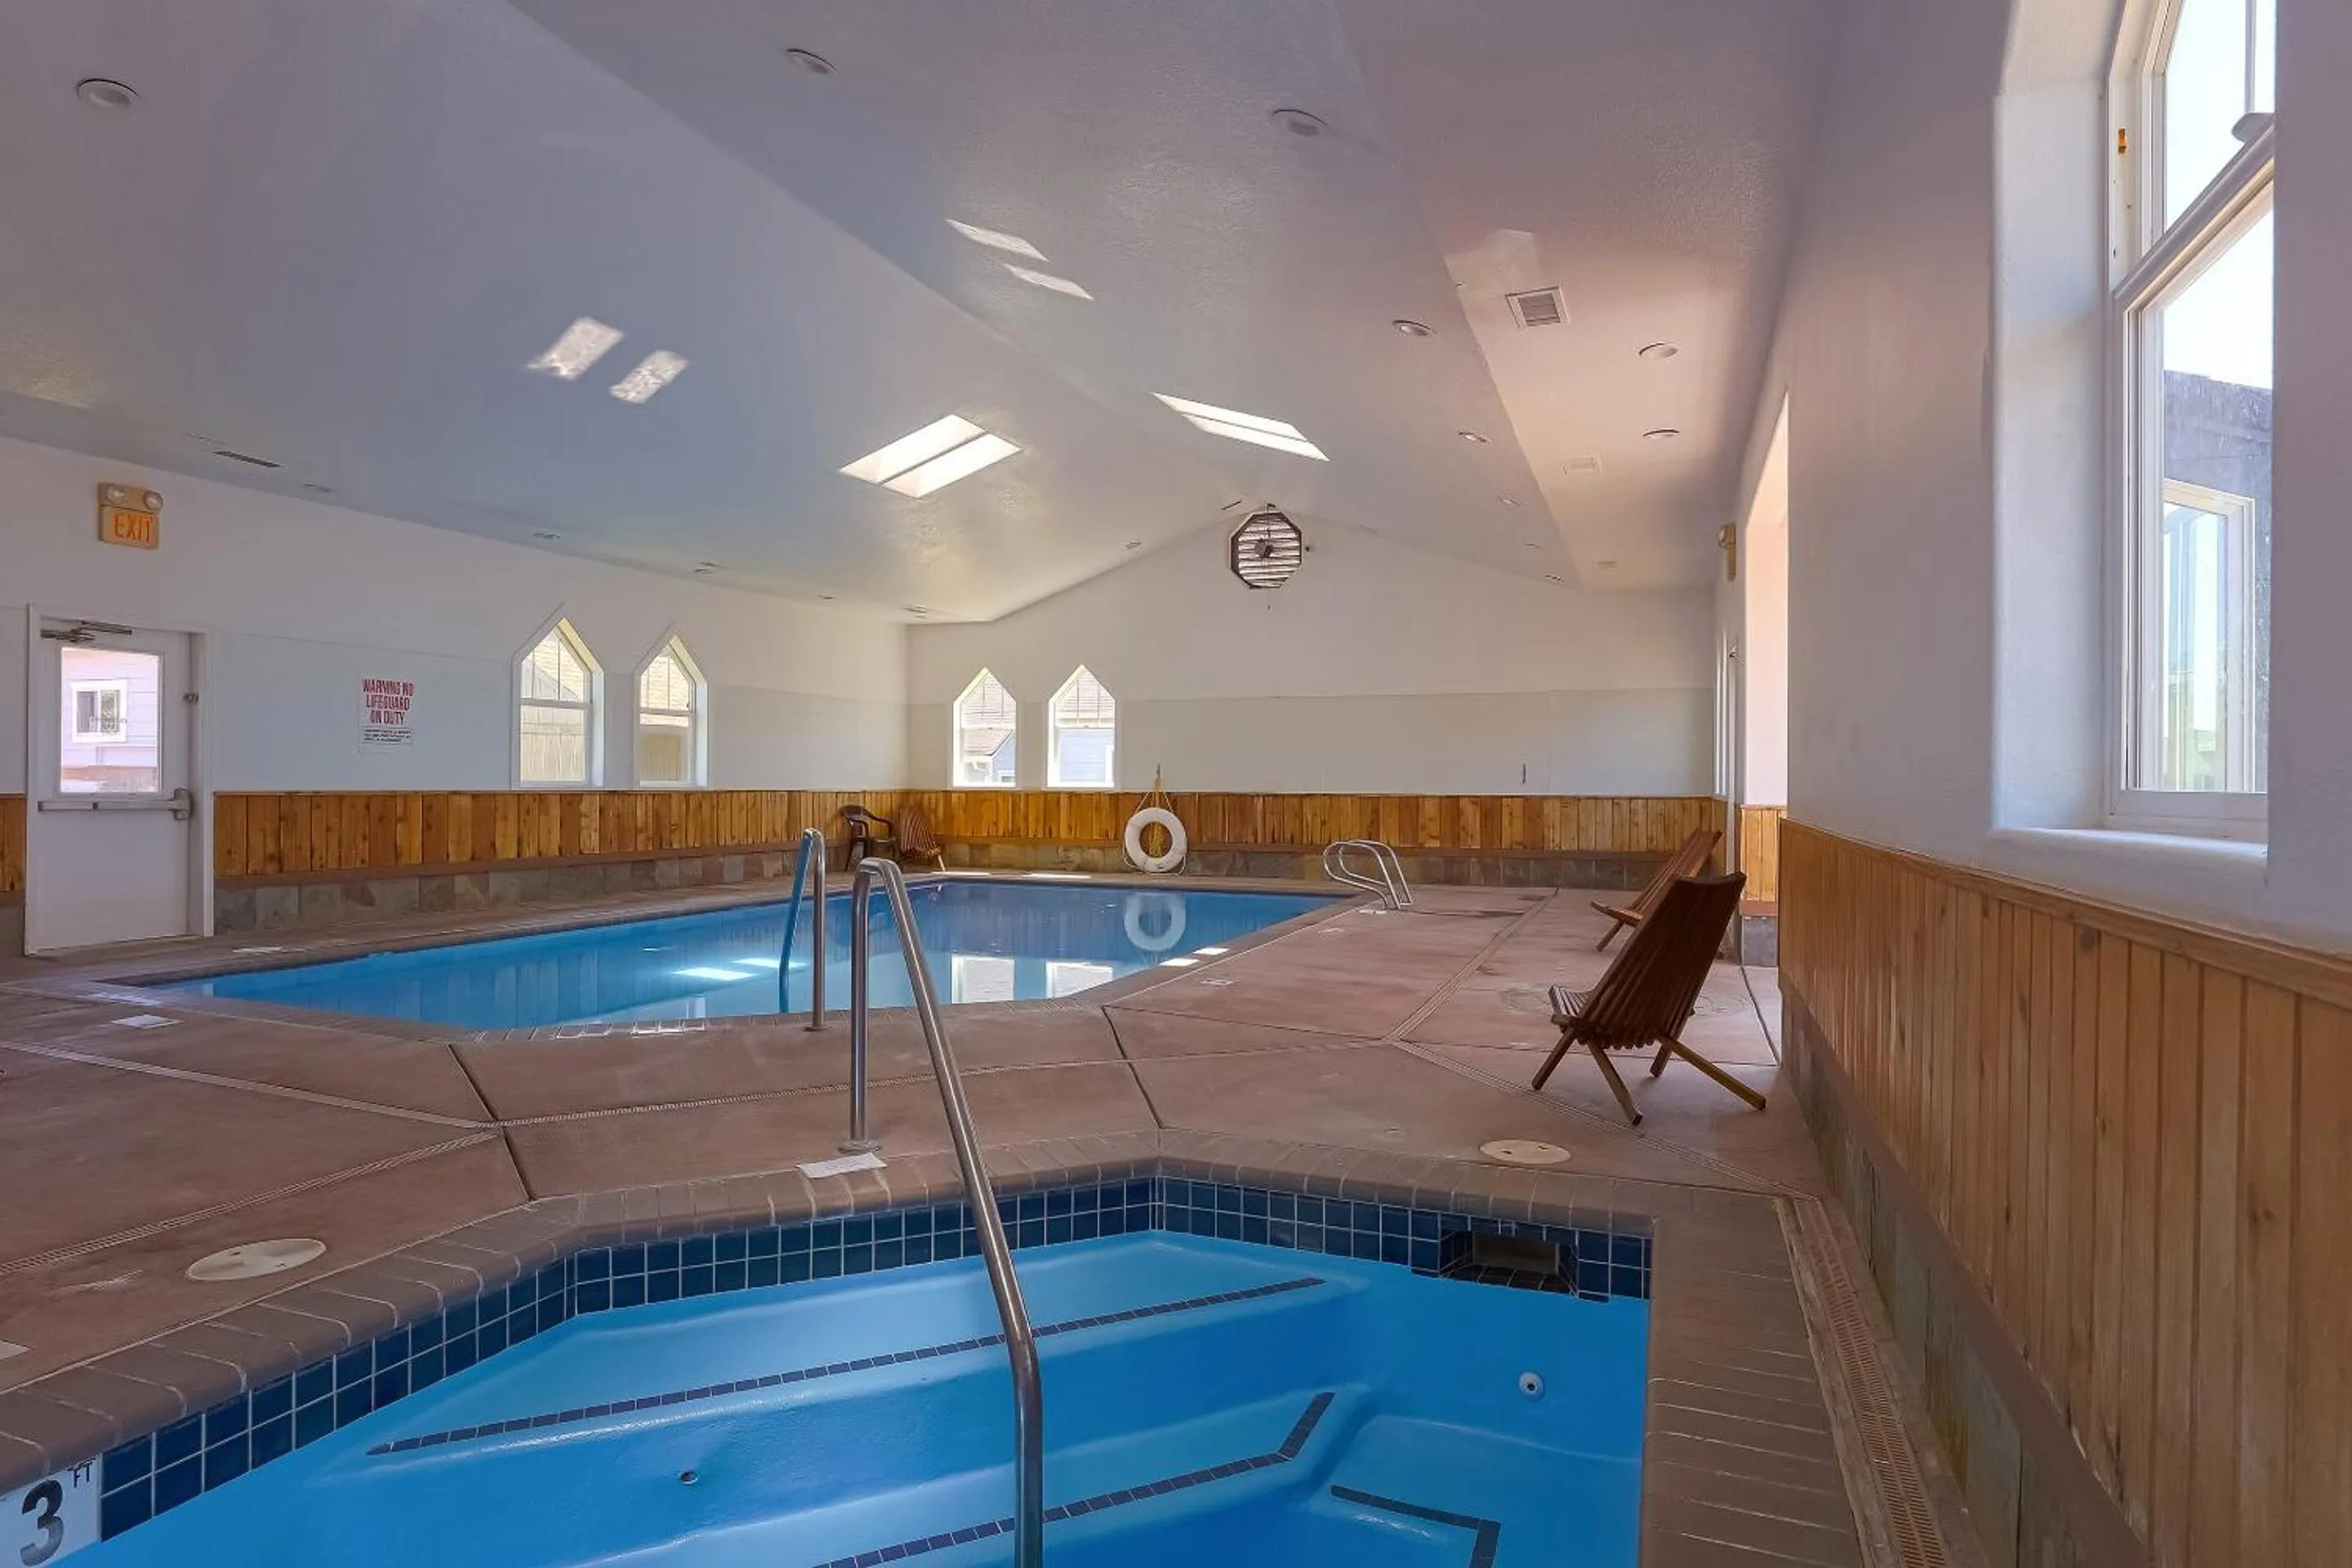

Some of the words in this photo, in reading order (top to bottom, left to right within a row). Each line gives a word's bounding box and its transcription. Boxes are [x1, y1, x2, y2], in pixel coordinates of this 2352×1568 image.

[114, 513, 154, 542] EXIT
[363, 678, 401, 695] WARNING
[403, 682, 414, 697] NO
[366, 693, 410, 710] LIFEGUARD
[371, 709, 382, 724] ON
[383, 710, 405, 725] DUTY
[20, 1479, 64, 1566] 3
